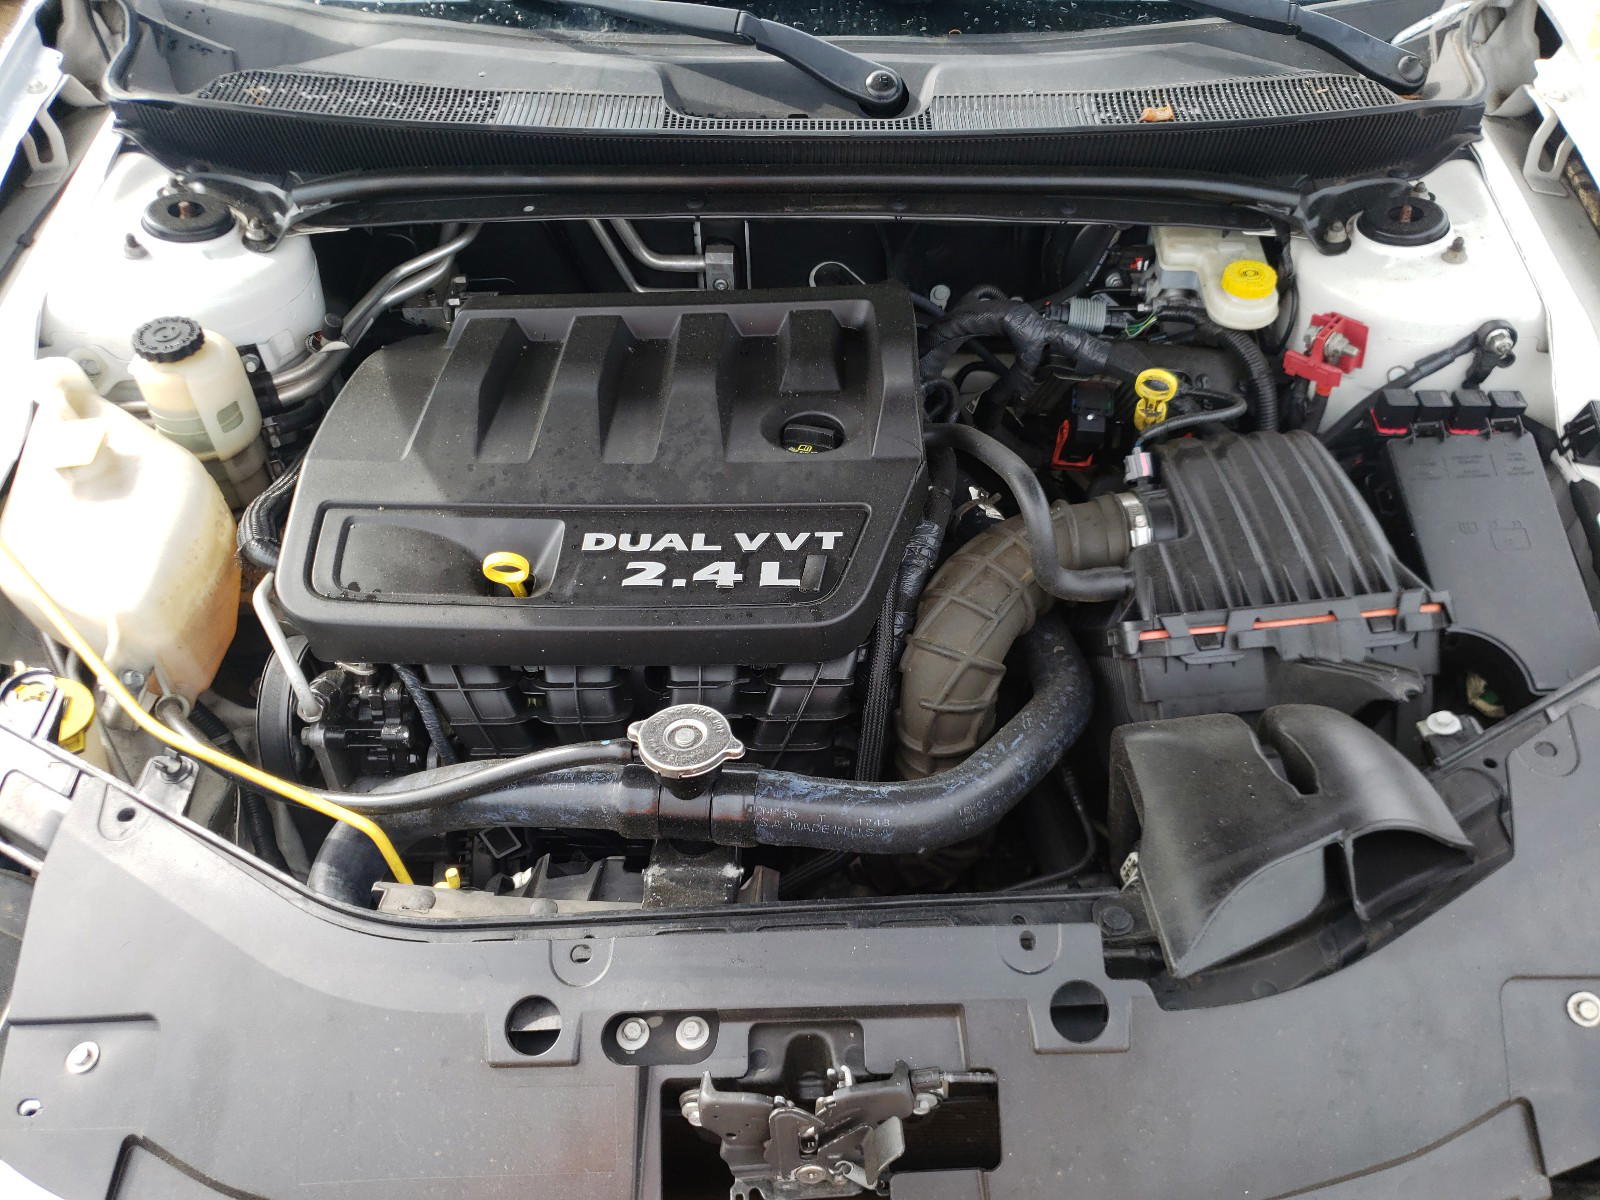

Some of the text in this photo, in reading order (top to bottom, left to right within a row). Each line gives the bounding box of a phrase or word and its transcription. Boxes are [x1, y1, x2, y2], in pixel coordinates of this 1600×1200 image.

[581, 531, 844, 553] DUAL VVT
[621, 561, 801, 588] 2.4 L
